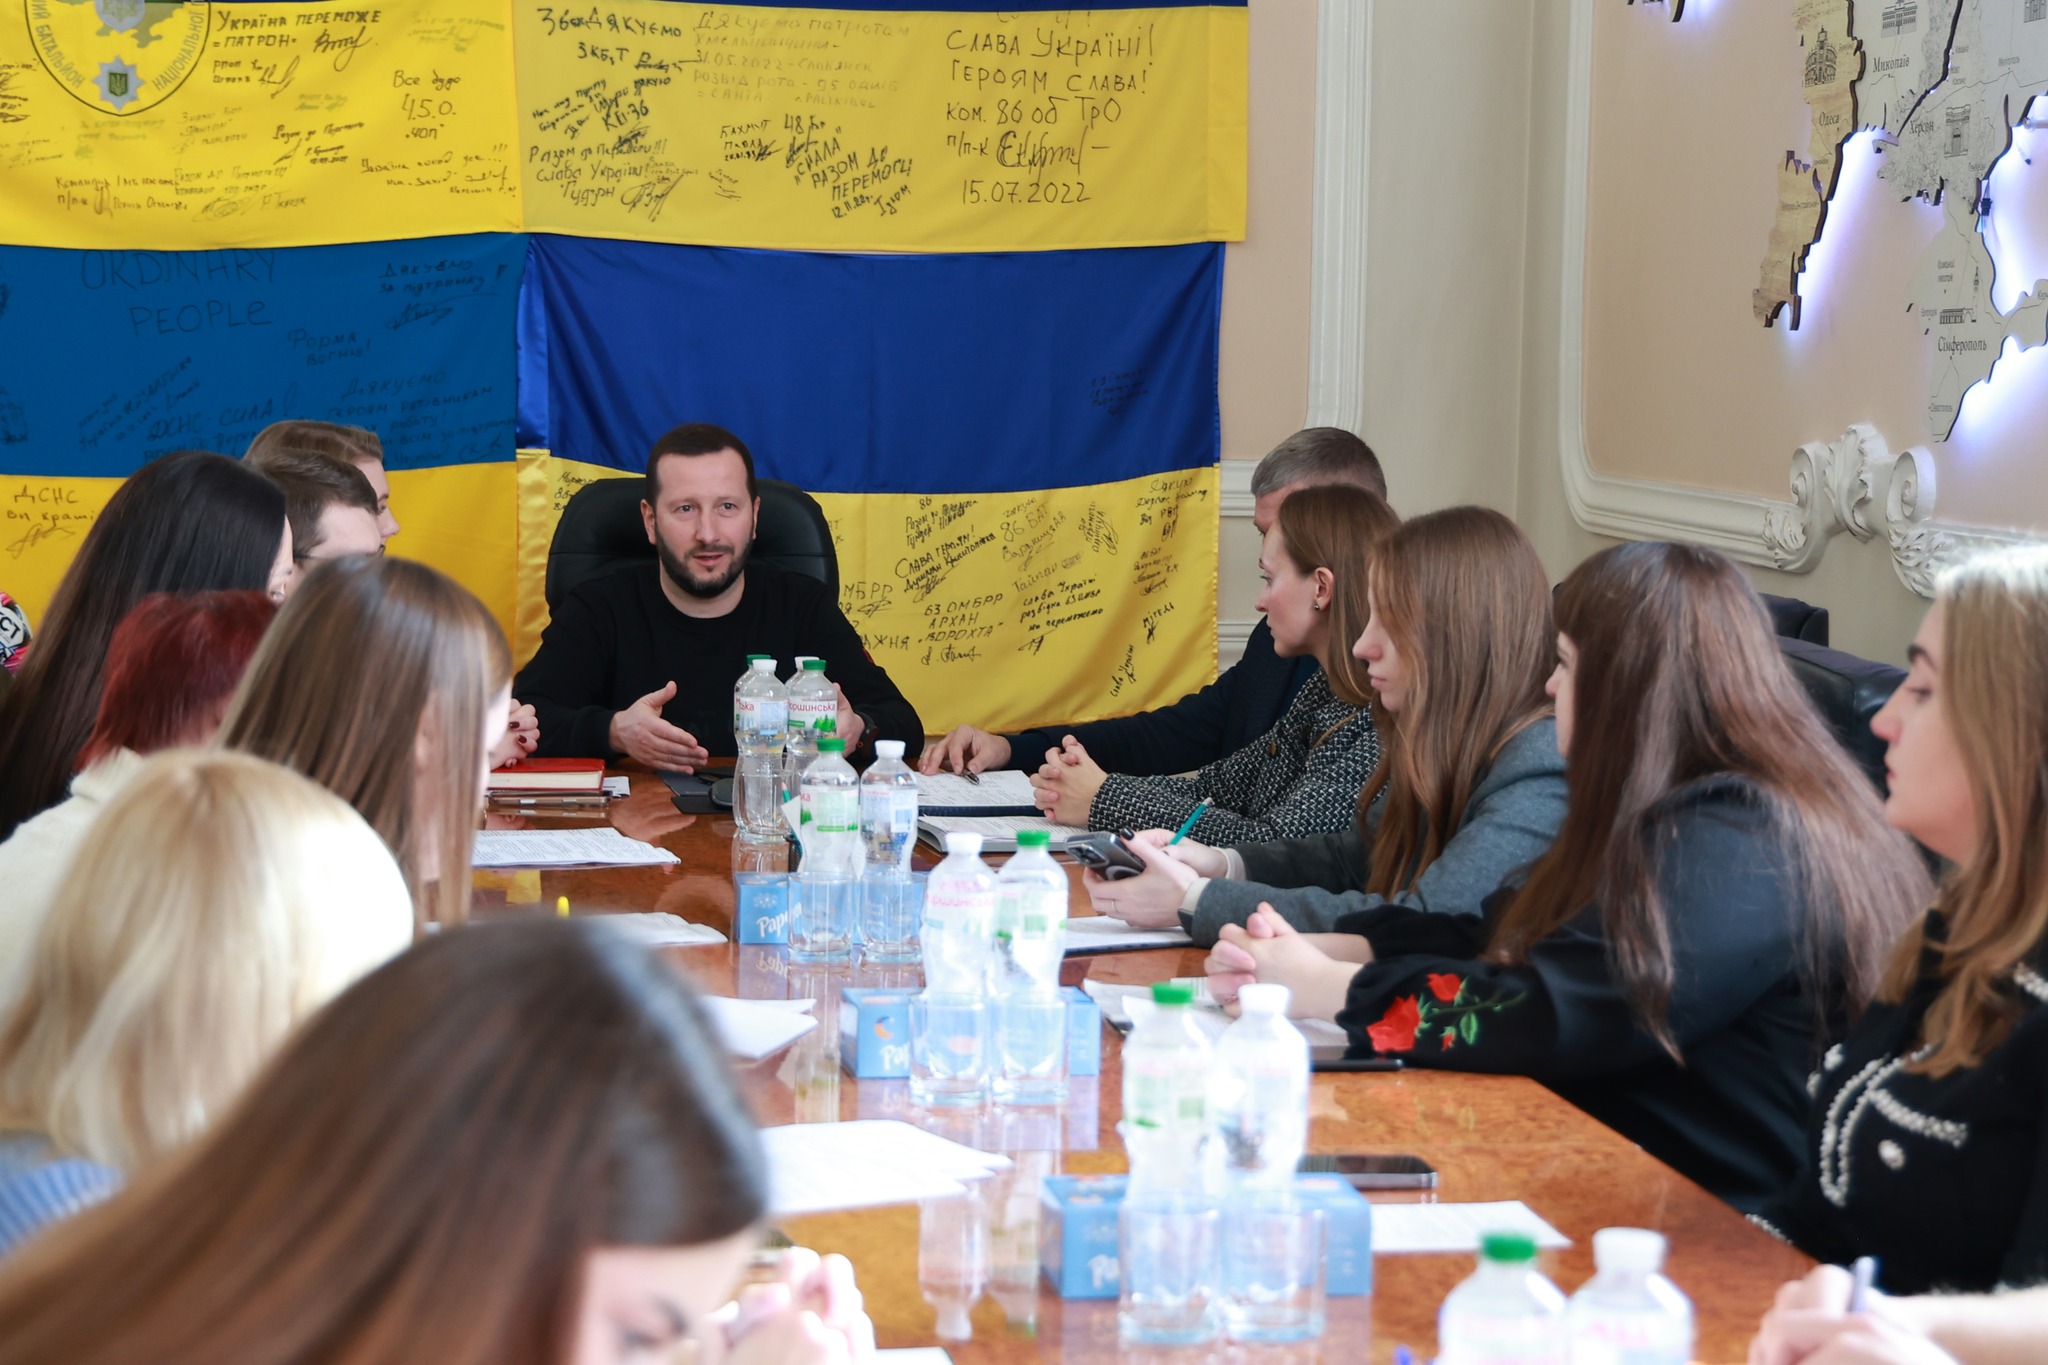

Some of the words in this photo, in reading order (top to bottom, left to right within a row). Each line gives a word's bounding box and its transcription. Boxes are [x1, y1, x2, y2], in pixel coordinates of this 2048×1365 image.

[36, 25, 86, 89] БАТАЛЬЙОН
[997, 99, 1022, 124] 86
[963, 180, 1092, 203] 15.07.2022
